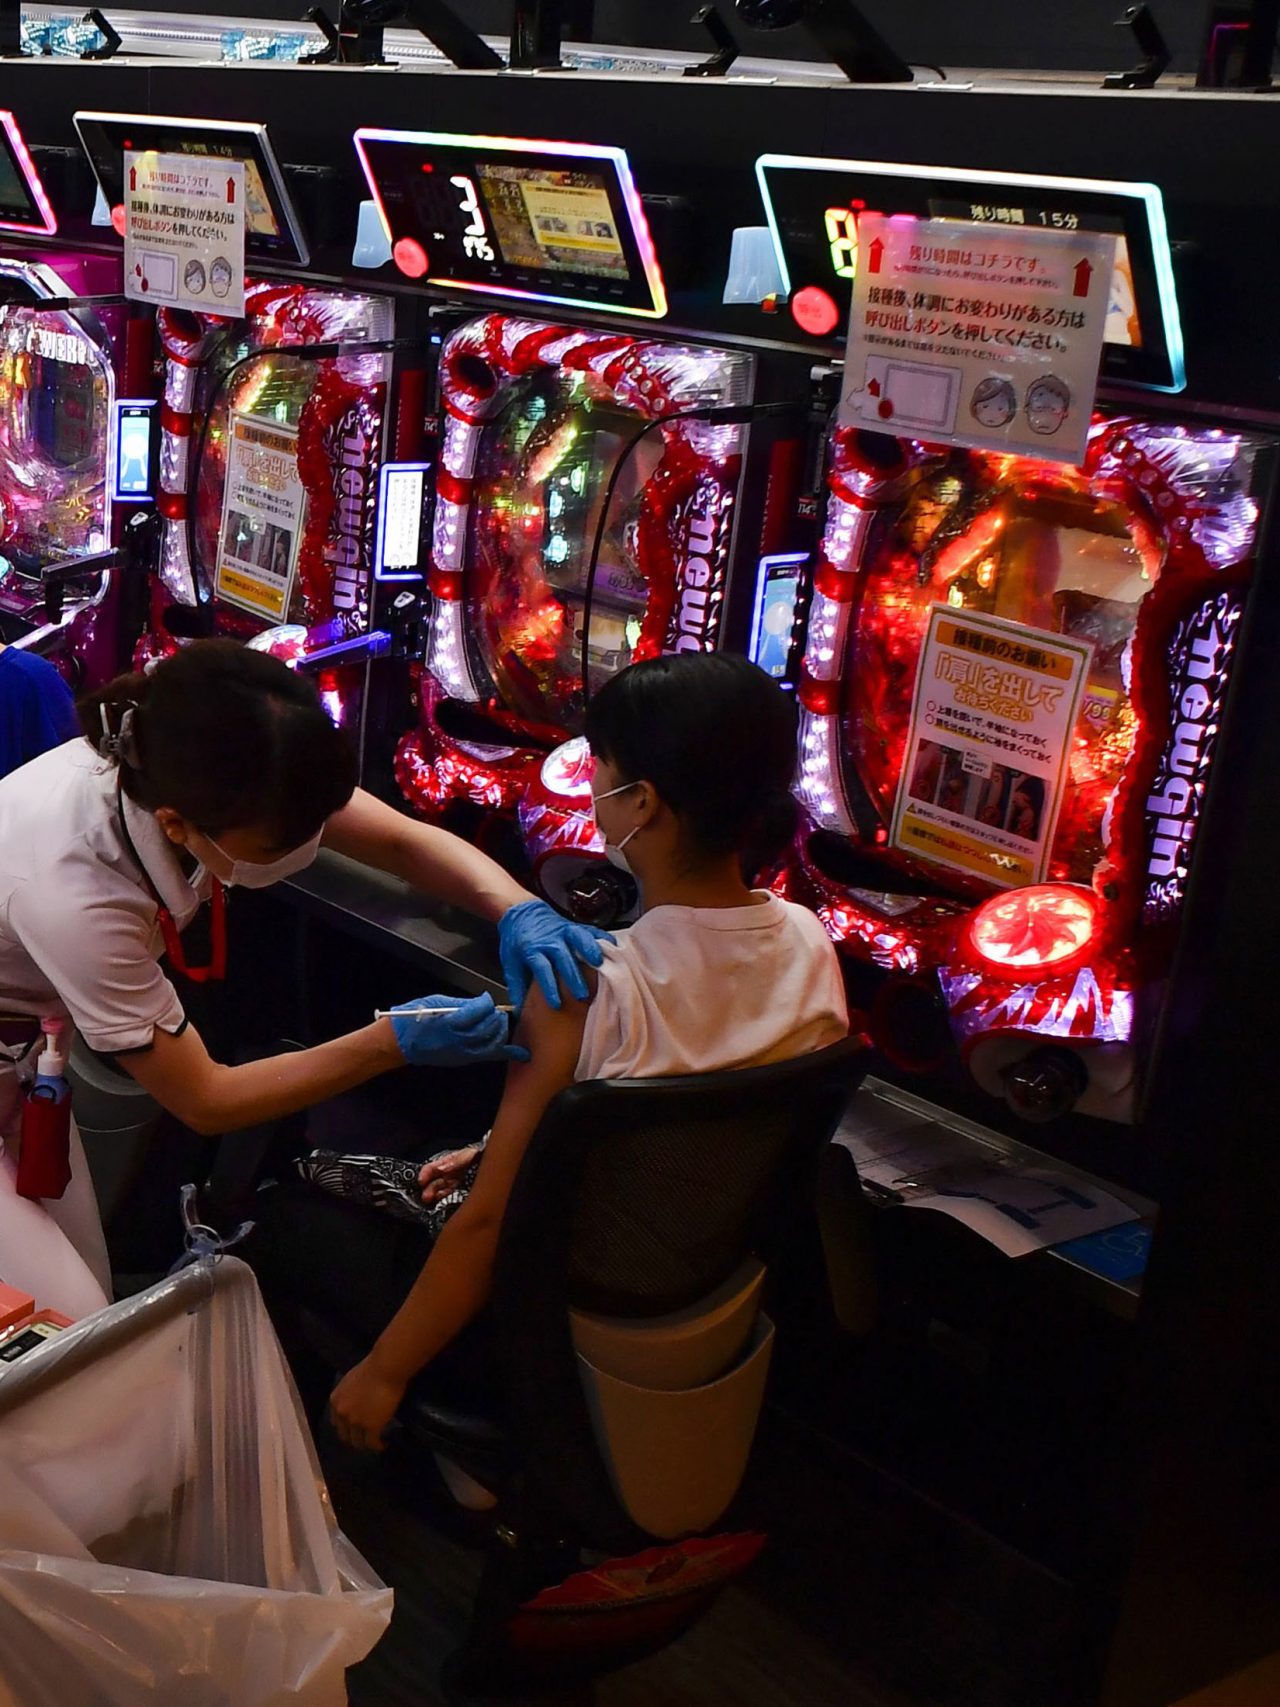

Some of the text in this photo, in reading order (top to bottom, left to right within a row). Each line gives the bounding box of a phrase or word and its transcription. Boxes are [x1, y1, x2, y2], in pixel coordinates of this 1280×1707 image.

[970, 204, 1079, 230] 残り時間 15分
[908, 244, 1047, 275] 残り時間はコチラです。
[867, 286, 1086, 330] 接種後、体調にお変わりがある方は
[864, 309, 1068, 353] 呼び出しボタンを押してください。
[324, 423, 369, 609] newgin
[934, 651, 1065, 714] 「肩」を出して
[953, 685, 1035, 723] お待ちください
[1145, 619, 1224, 877] newgin
